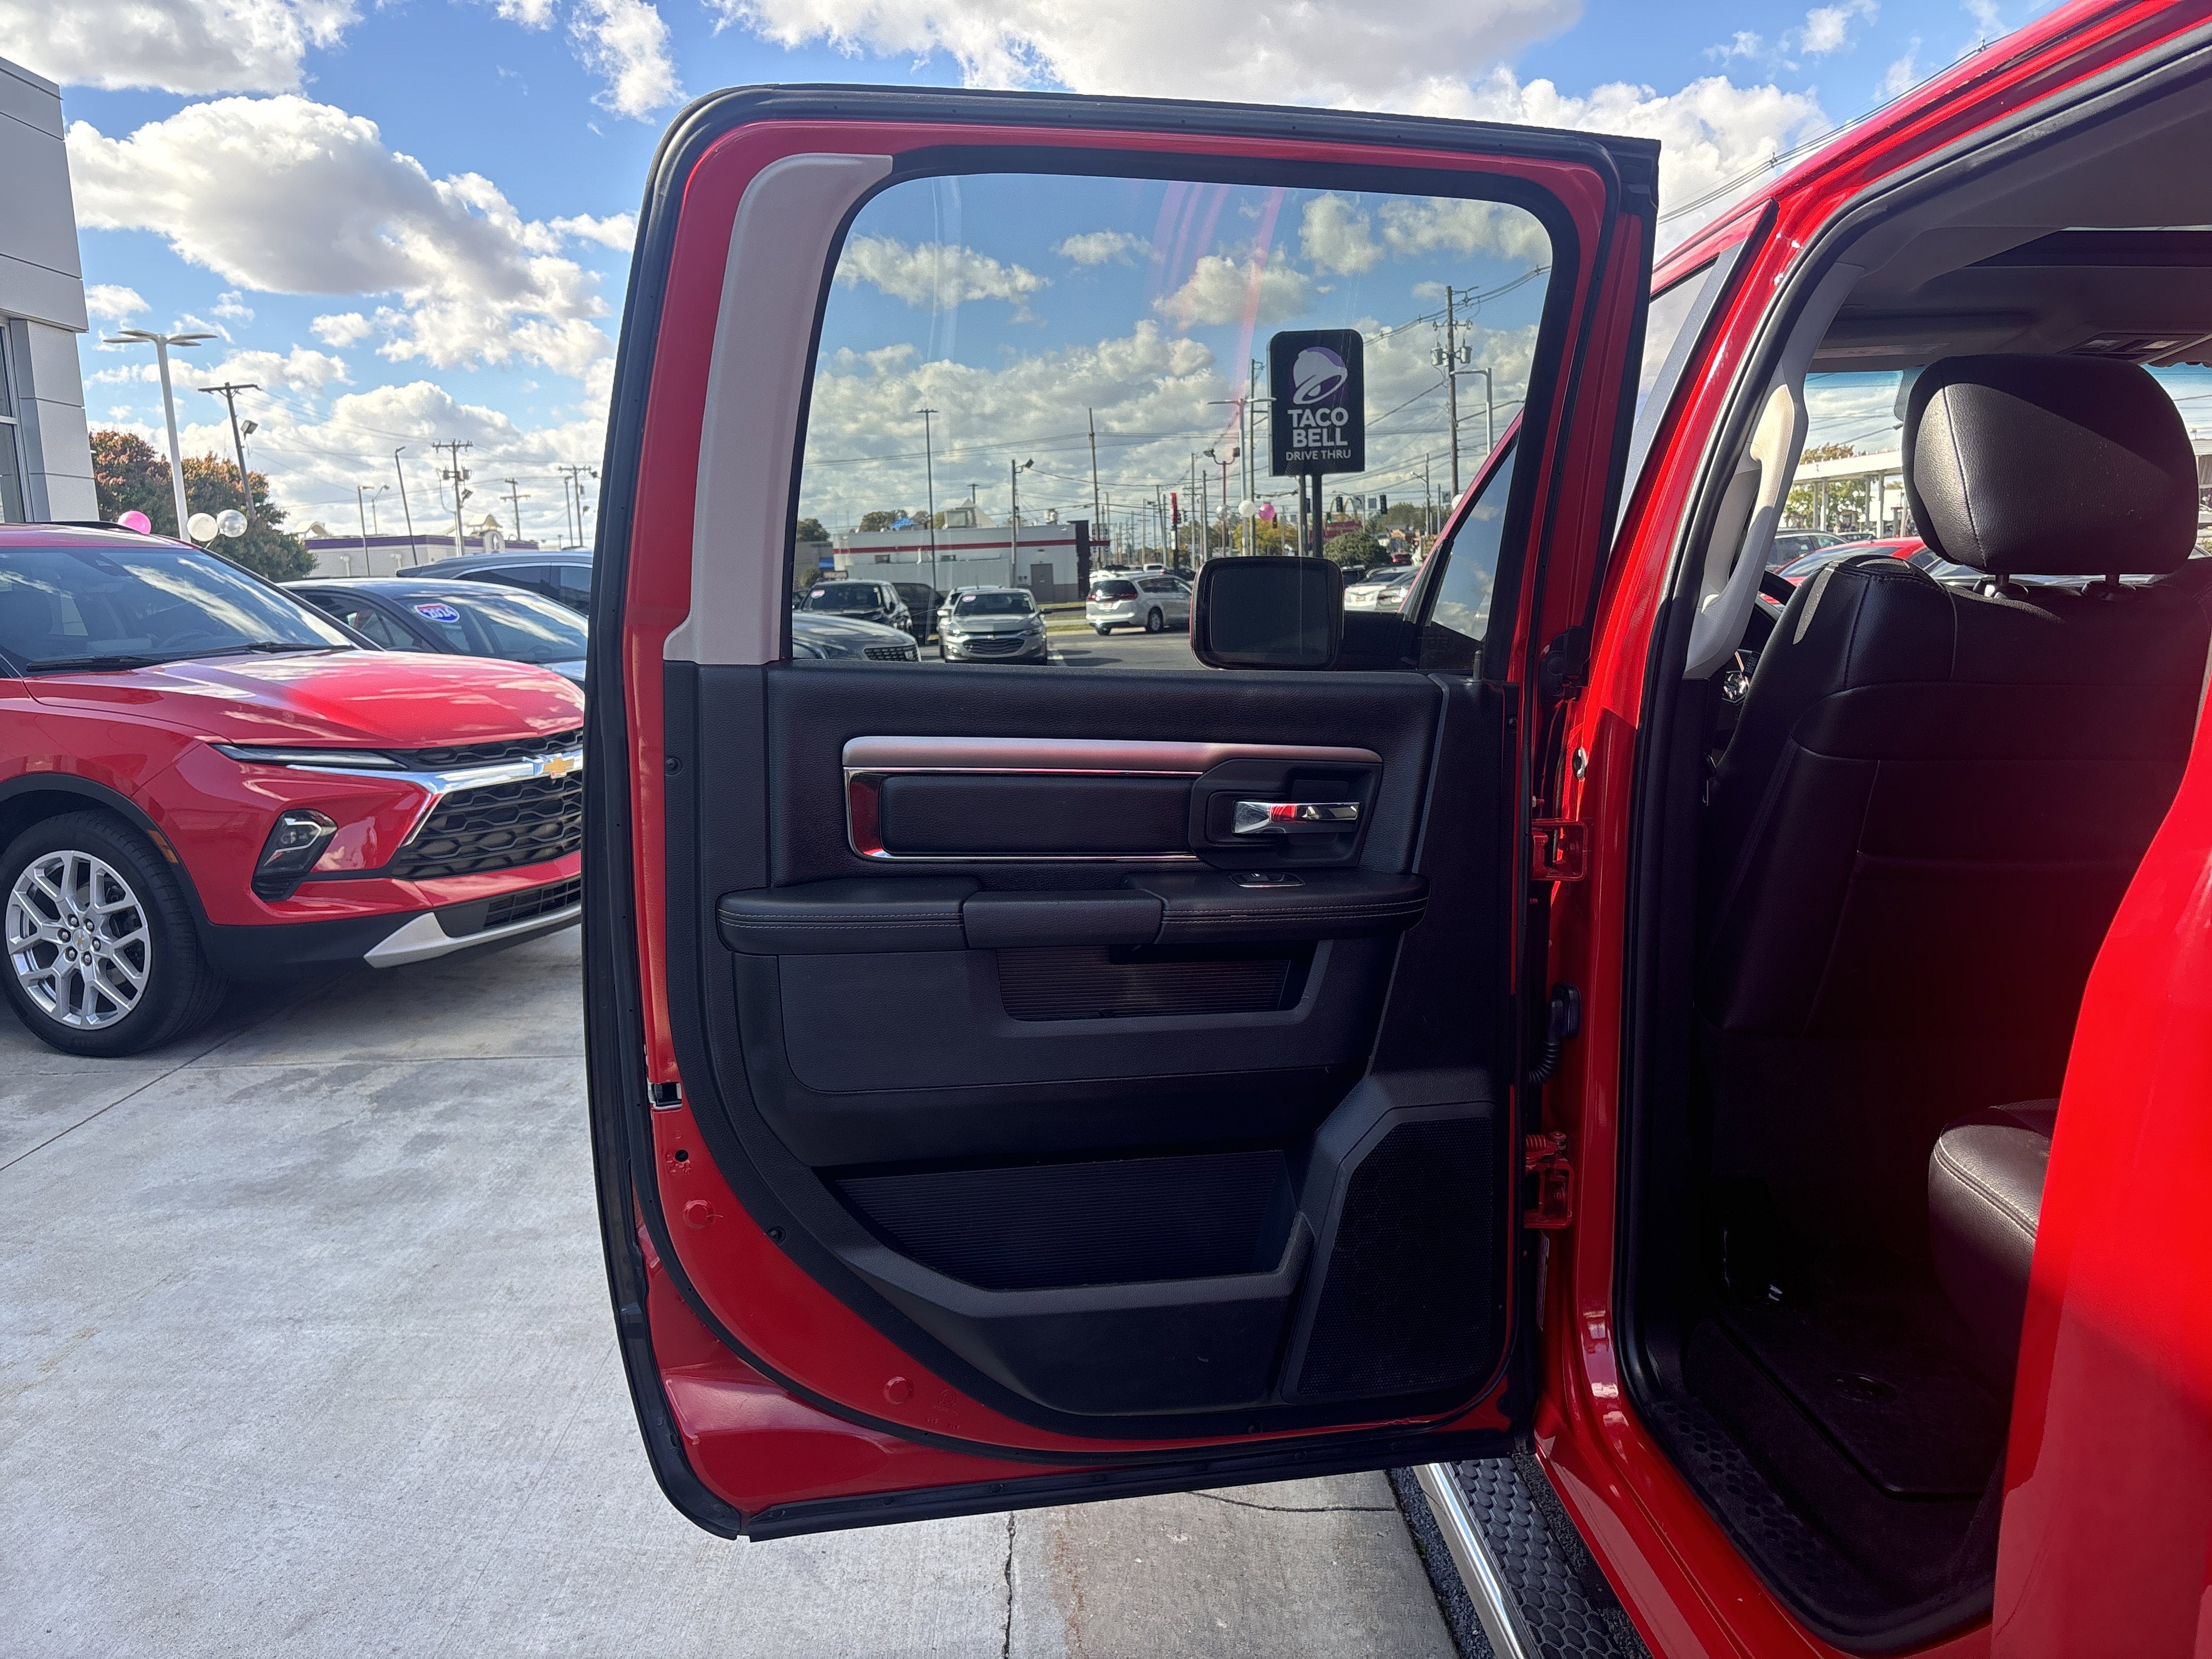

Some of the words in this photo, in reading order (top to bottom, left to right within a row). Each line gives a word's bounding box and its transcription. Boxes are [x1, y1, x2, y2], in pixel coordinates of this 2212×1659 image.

[1288, 408, 1348, 427] TACO
[1293, 428, 1348, 448] BELL
[1285, 451, 1318, 461] DRIVE
[1321, 449, 1351, 459] THRU
